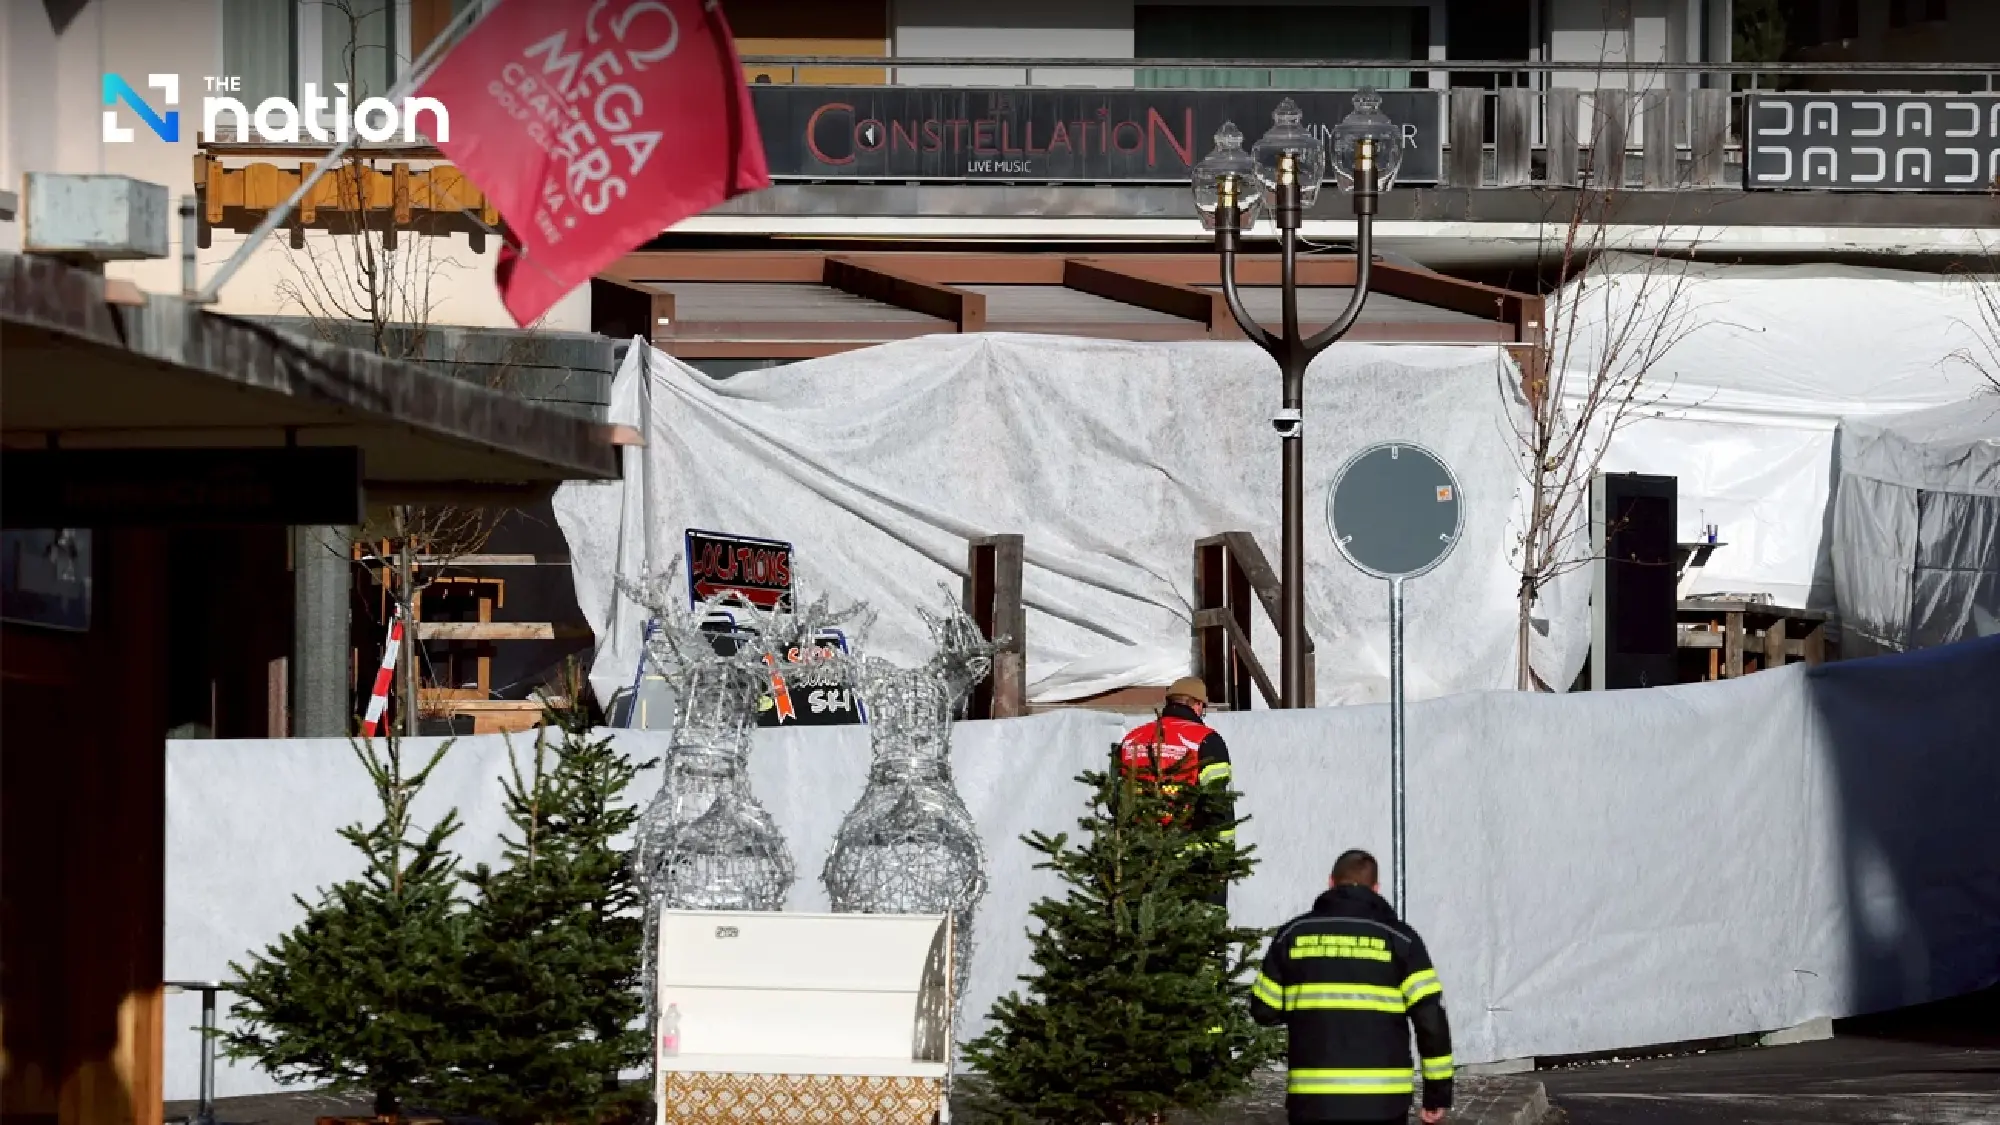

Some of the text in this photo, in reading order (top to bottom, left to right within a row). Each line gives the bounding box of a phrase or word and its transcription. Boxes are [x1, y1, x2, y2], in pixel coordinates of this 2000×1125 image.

[967, 160, 1032, 174] LIVE MUSIC
[693, 541, 790, 587] LOCATIONS
[808, 688, 851, 714] SKI
